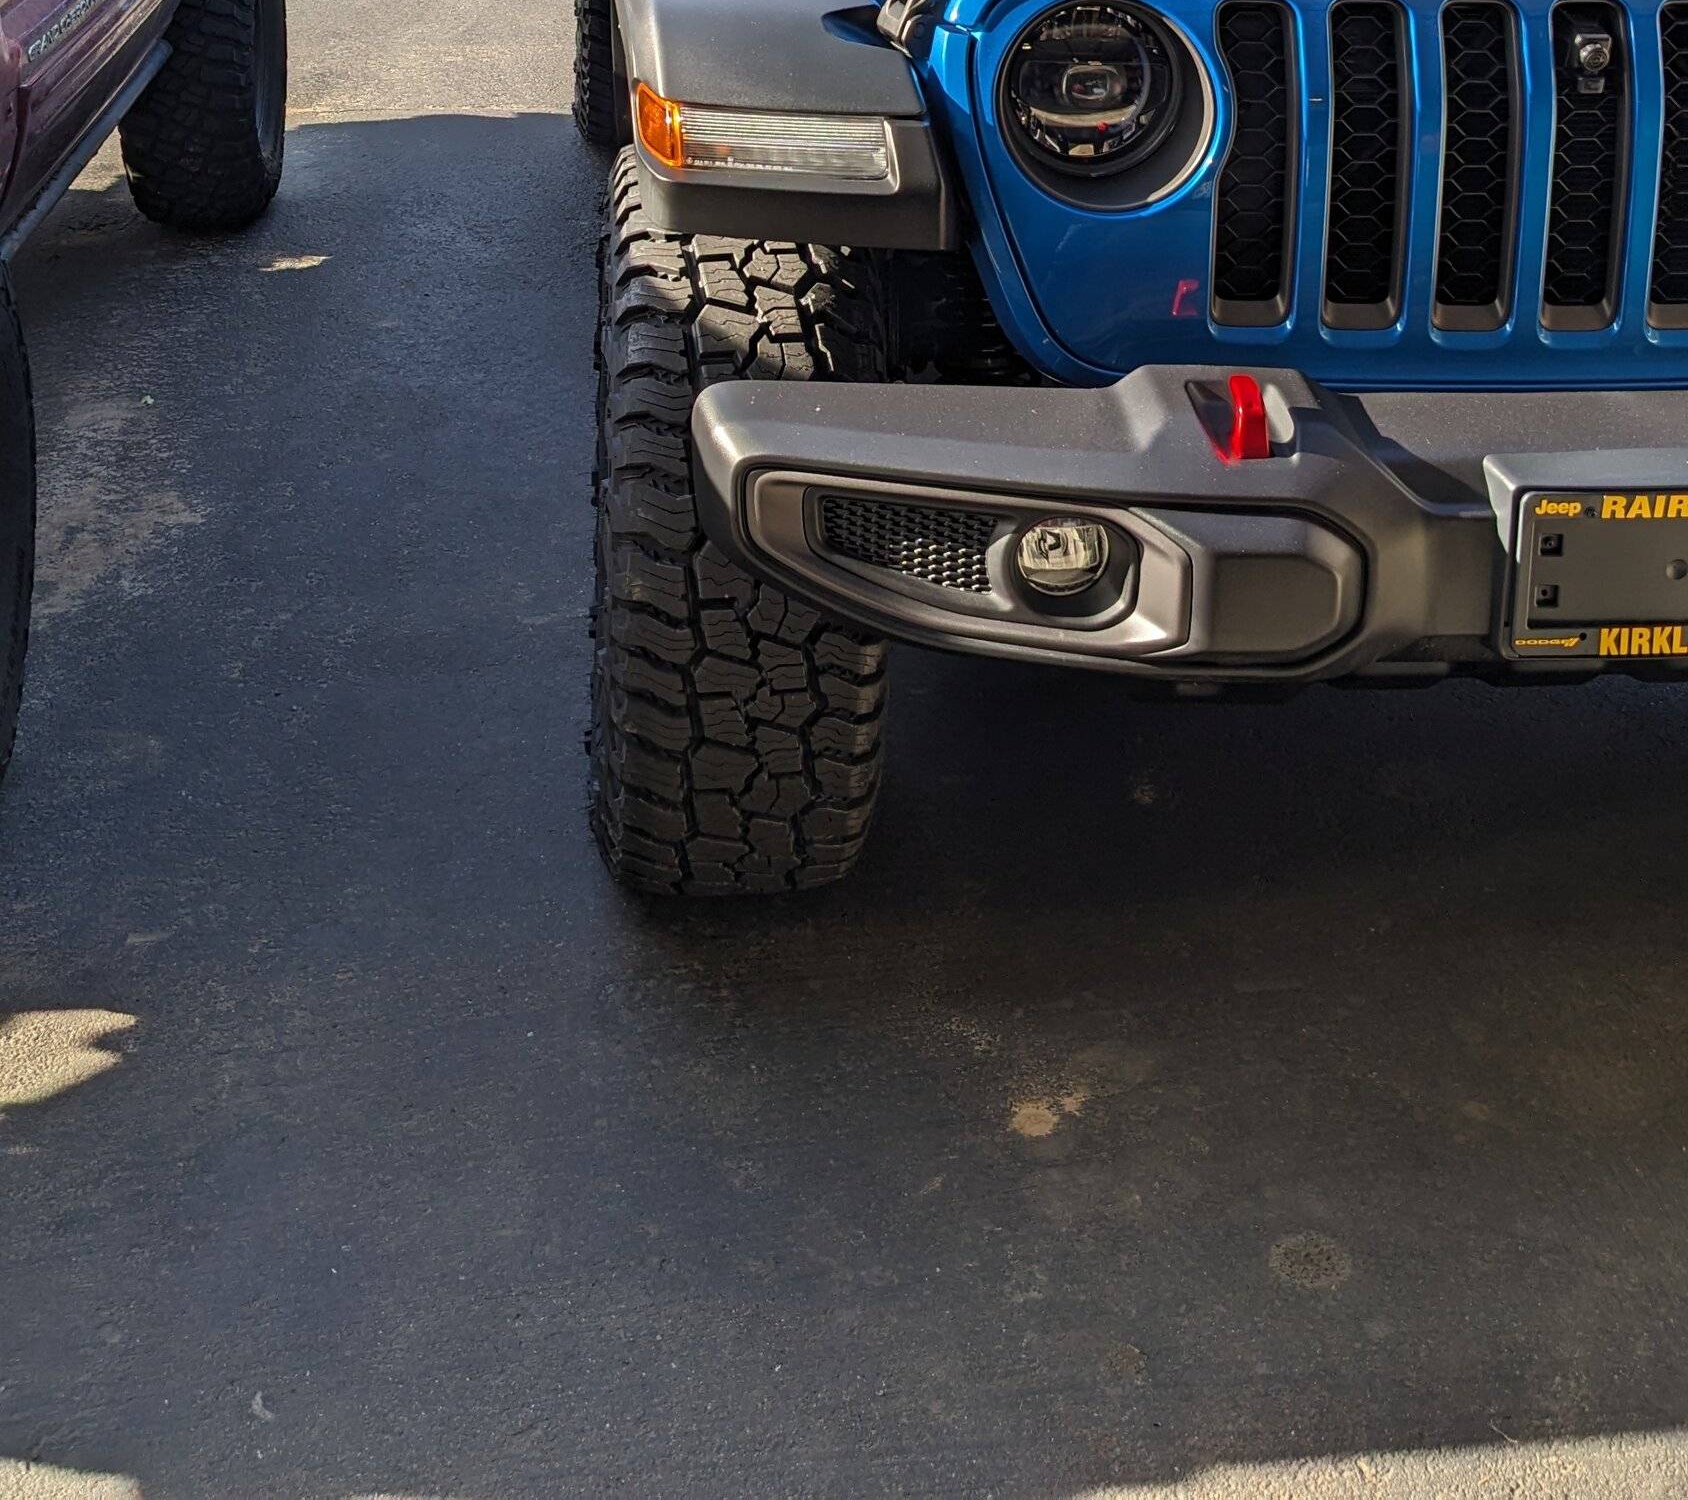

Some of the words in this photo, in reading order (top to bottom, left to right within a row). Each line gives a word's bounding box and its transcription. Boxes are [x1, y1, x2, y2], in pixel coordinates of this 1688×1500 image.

[1535, 499, 1582, 517] Jeep
[1601, 494, 1688, 519] RAIR
[1599, 626, 1688, 656] KIRKL
